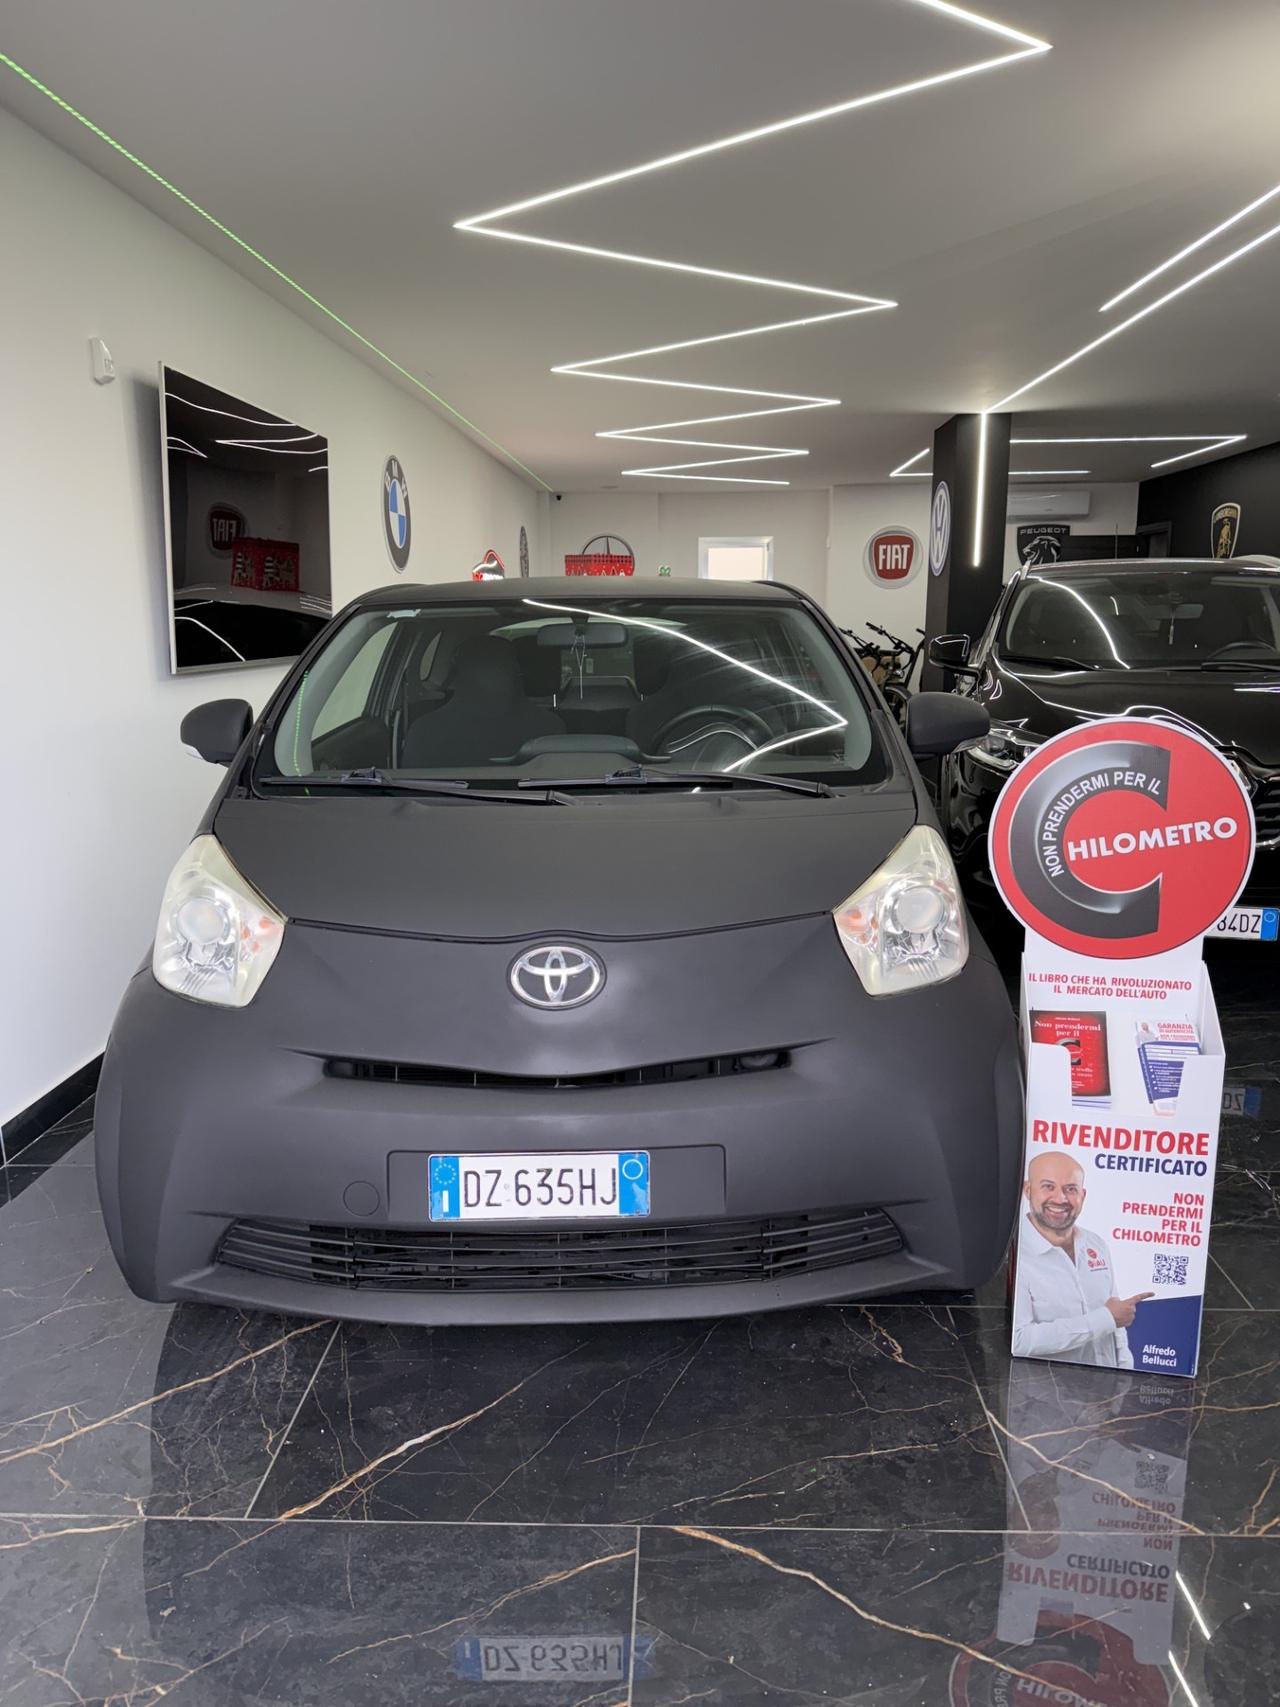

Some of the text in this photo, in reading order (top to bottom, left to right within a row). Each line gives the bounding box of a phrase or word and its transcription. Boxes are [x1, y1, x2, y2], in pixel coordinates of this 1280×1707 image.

[1020, 527, 1067, 536] PEUGEOT
[878, 544, 910, 570] FIAT
[1043, 770, 1162, 877] NON PRENDERMI PER IL
[1028, 972, 1192, 991] IL LIBRO CHE HA RIVOLUZIONATO
[1053, 985, 1167, 1000] IL MERCATO DELL'AUTO
[1034, 1020, 1052, 1028] Non
[1032, 1120, 1210, 1156] RIVENDITORE
[1094, 1153, 1208, 1177] CERTIFICATO
[463, 1169, 502, 1208] DZ
[514, 1167, 617, 1206] 635HJ
[1173, 1192, 1205, 1207] NON
[1122, 1202, 1203, 1220] PRENDERMI
[1161, 1219, 1203, 1234] PER IL
[1112, 1228, 1202, 1247] CHILOMETRO
[1142, 1344, 1176, 1357] Alfredo
[1142, 1355, 1177, 1368] Bellucci
